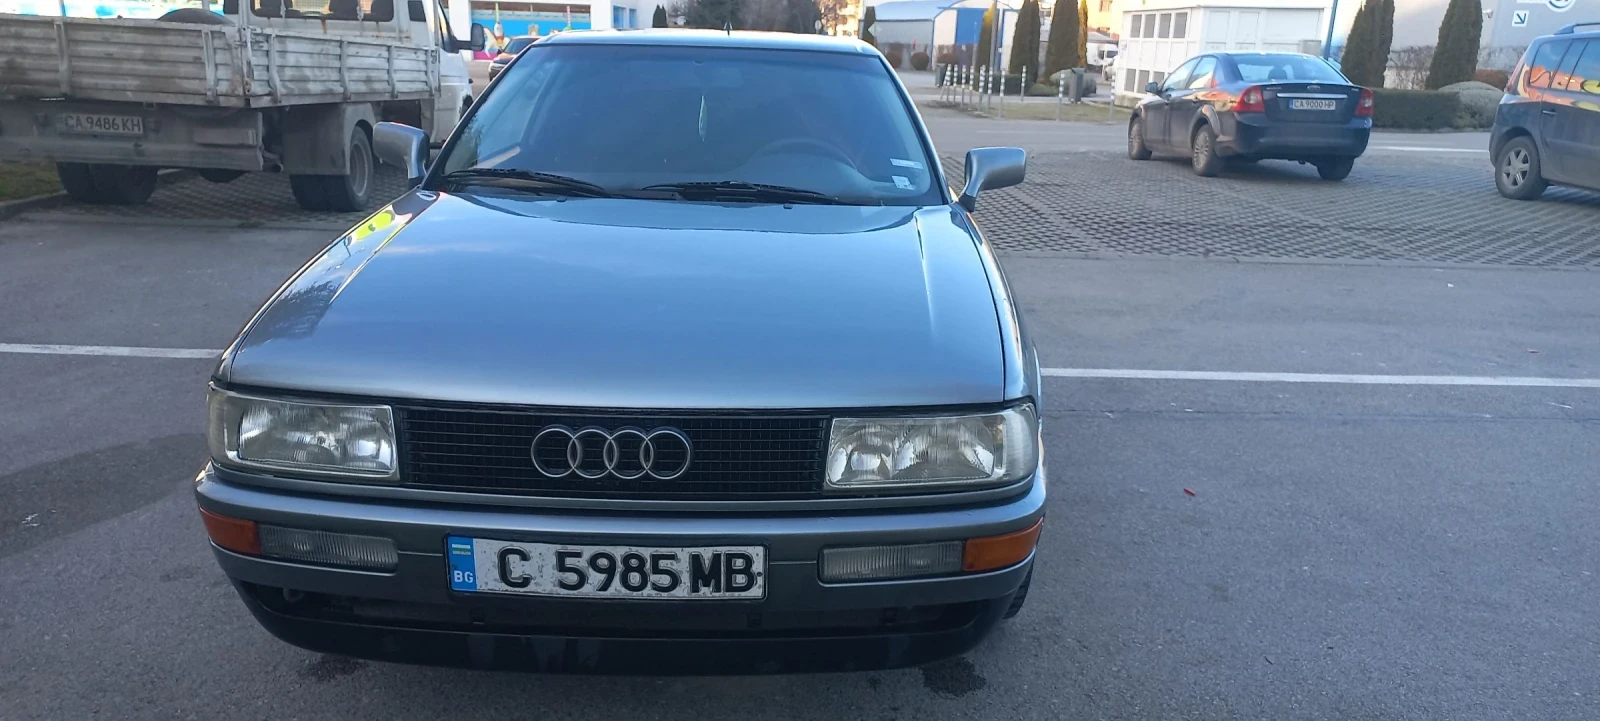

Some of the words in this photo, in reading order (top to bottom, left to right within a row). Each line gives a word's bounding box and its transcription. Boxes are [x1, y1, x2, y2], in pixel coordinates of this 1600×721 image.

[64, 115, 83, 129] CA
[86, 116, 120, 131] 9486
[121, 118, 141, 132] KH
[453, 570, 474, 583] BG
[497, 546, 532, 588] C
[556, 549, 682, 593] 5985
[689, 551, 757, 593] MB
